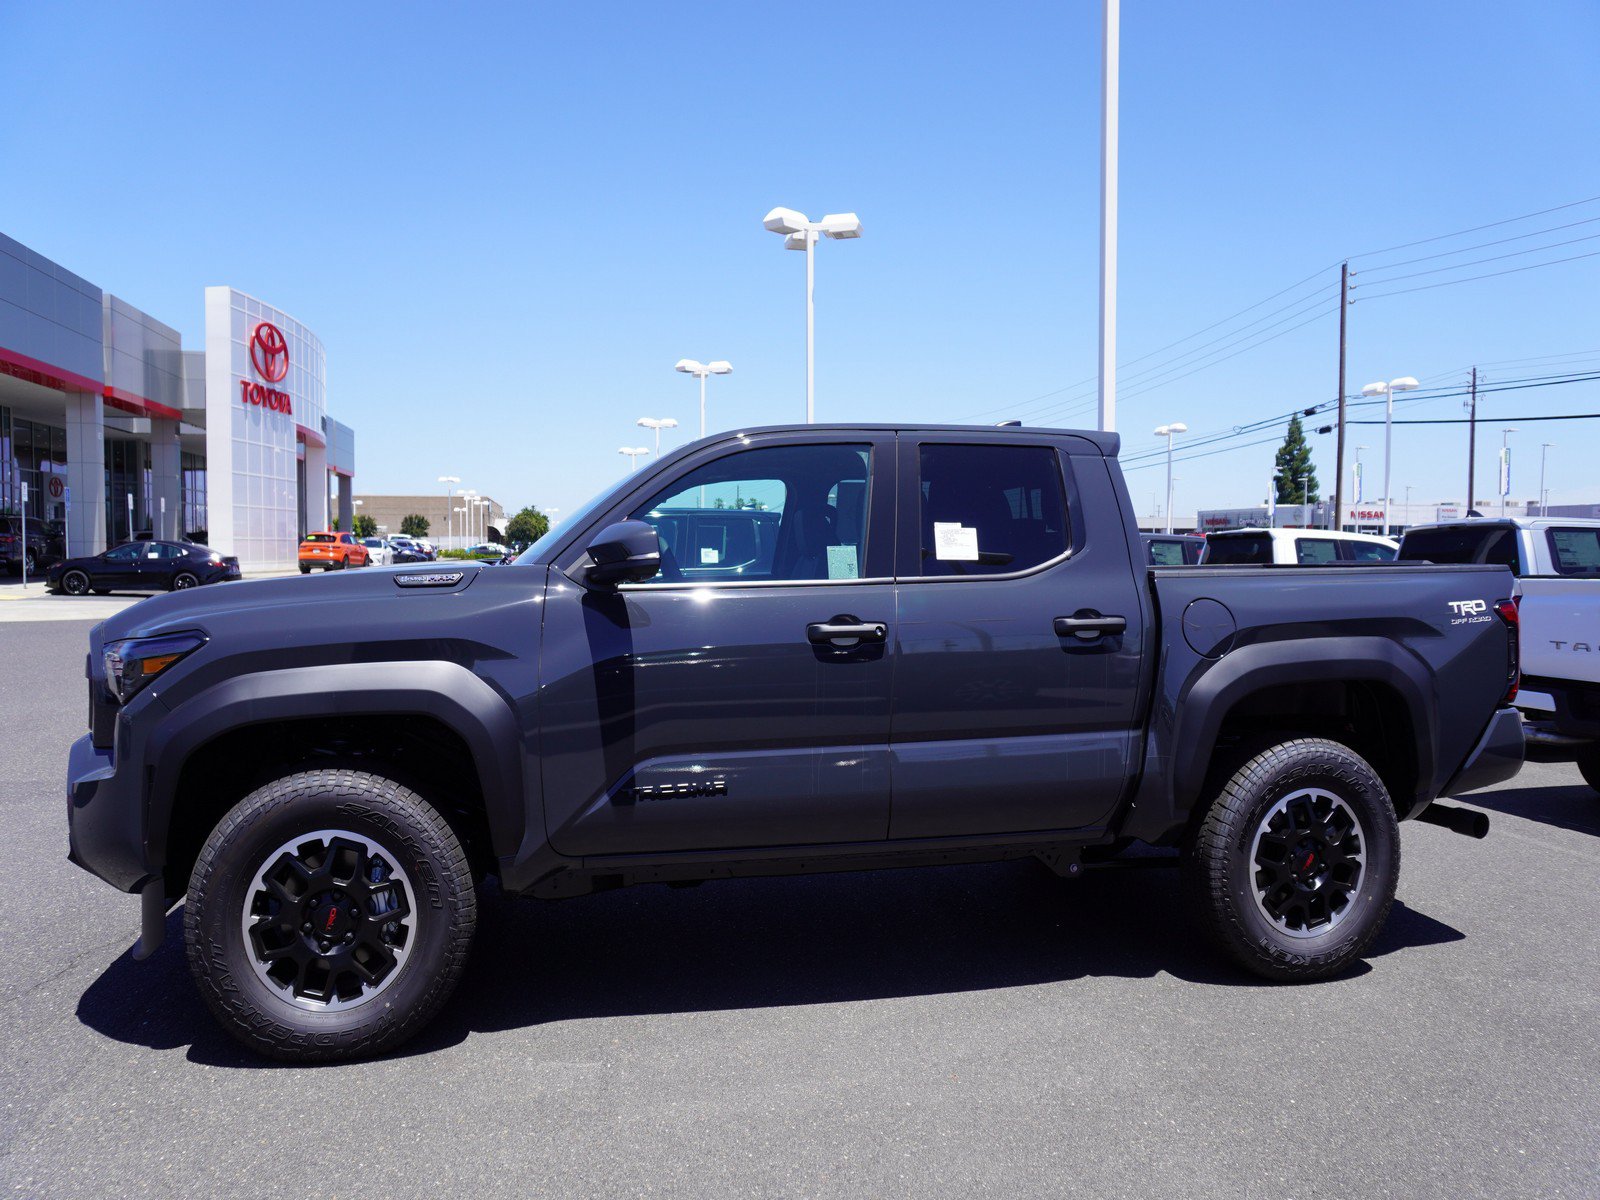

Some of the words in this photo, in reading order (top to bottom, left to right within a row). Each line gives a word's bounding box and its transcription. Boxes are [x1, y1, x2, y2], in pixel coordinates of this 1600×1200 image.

[240, 380, 292, 415] TOYOTA
[1350, 510, 1385, 520] NISSAN
[1448, 599, 1487, 616] TRD
[1451, 617, 1467, 625] OFF
[1468, 616, 1492, 624] ROAD
[1549, 640, 1600, 653] TA
[325, 907, 337, 931] TRD
